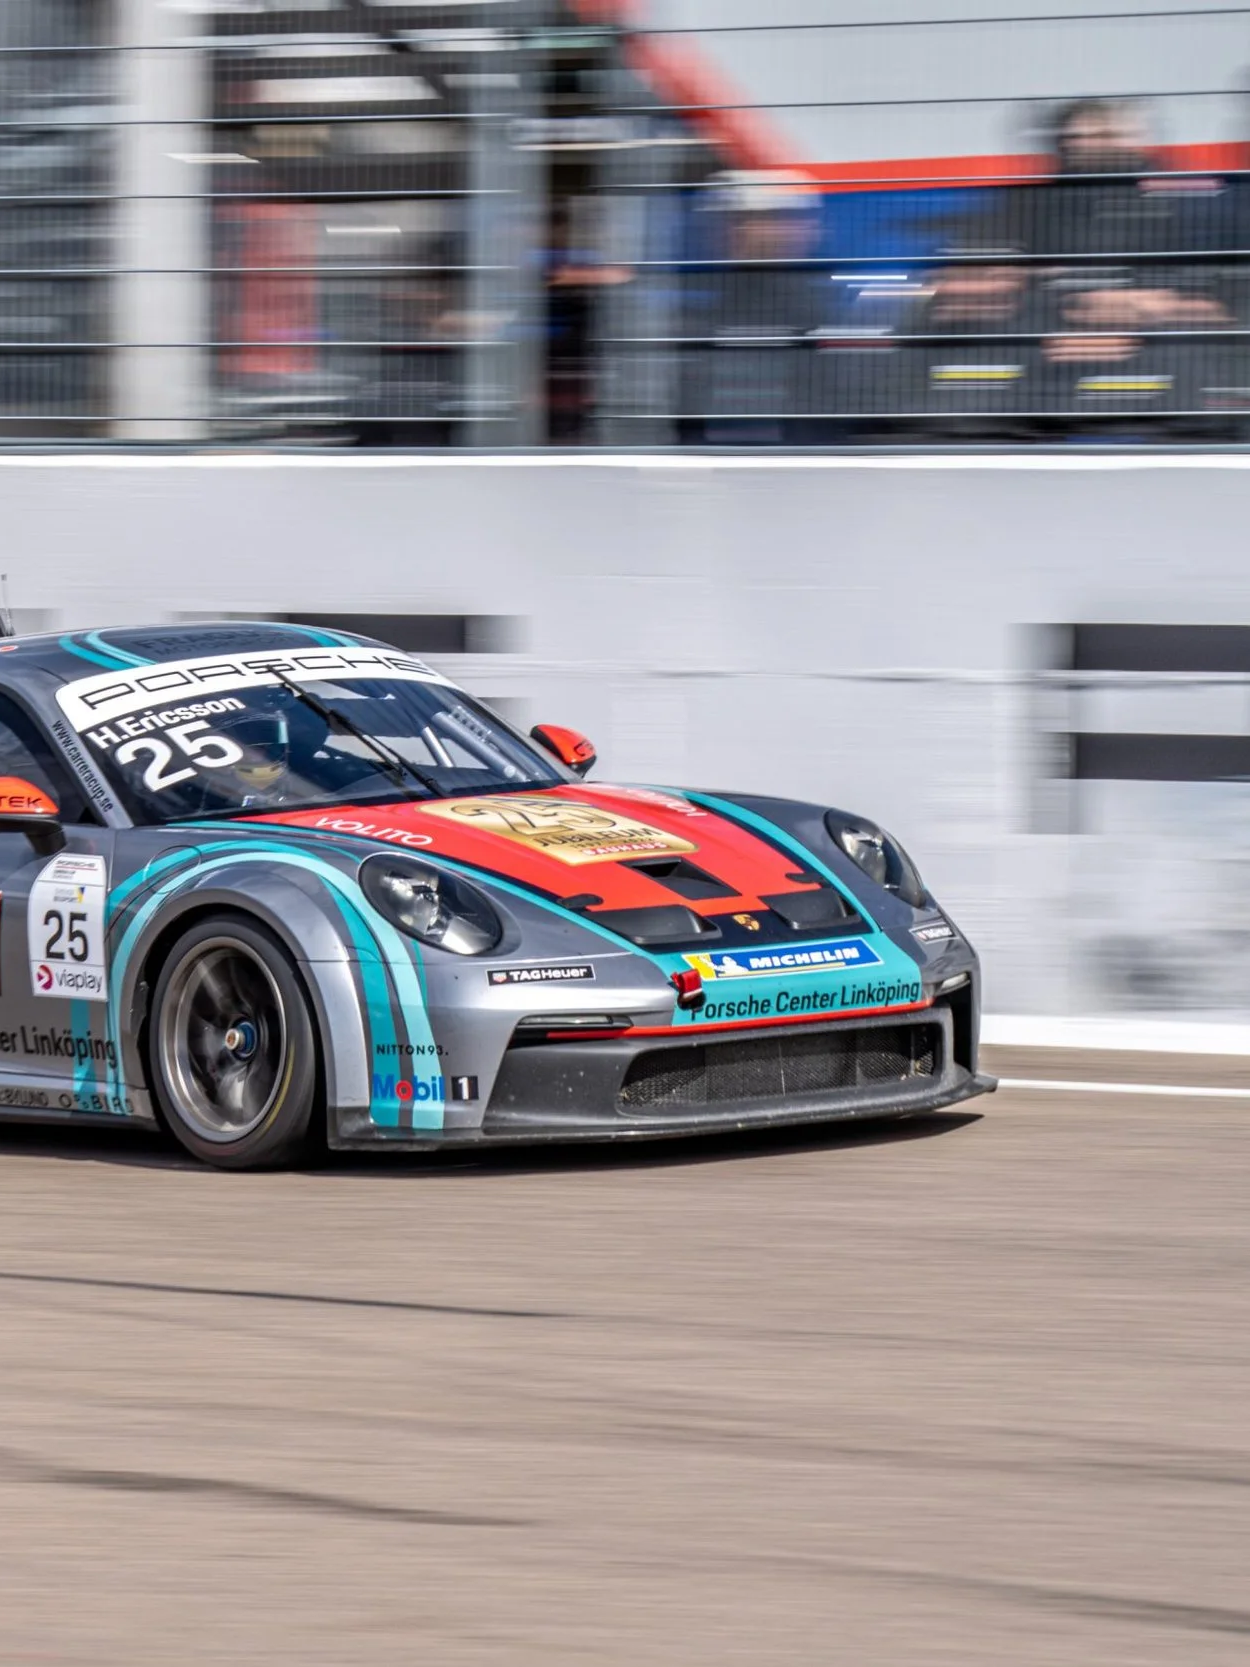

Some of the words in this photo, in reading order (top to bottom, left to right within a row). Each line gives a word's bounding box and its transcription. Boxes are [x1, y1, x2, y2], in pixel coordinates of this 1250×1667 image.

[78, 654, 440, 710] PORSCHE
[51, 720, 113, 813] www.carreracup.se
[115, 720, 244, 792] 25
[314, 817, 433, 846] VOLITO
[451, 796, 617, 836] 25
[533, 827, 665, 848] JUBILEUM
[43, 909, 89, 962] 25
[750, 948, 860, 968] MICHELIN
[55, 969, 103, 993] viaplay
[776, 991, 837, 1013] Center
[842, 979, 920, 1007] Linköping
[20, 1025, 118, 1069] Linköping
[372, 1073, 445, 1102] Mobil
[458, 1077, 470, 1100] 1
